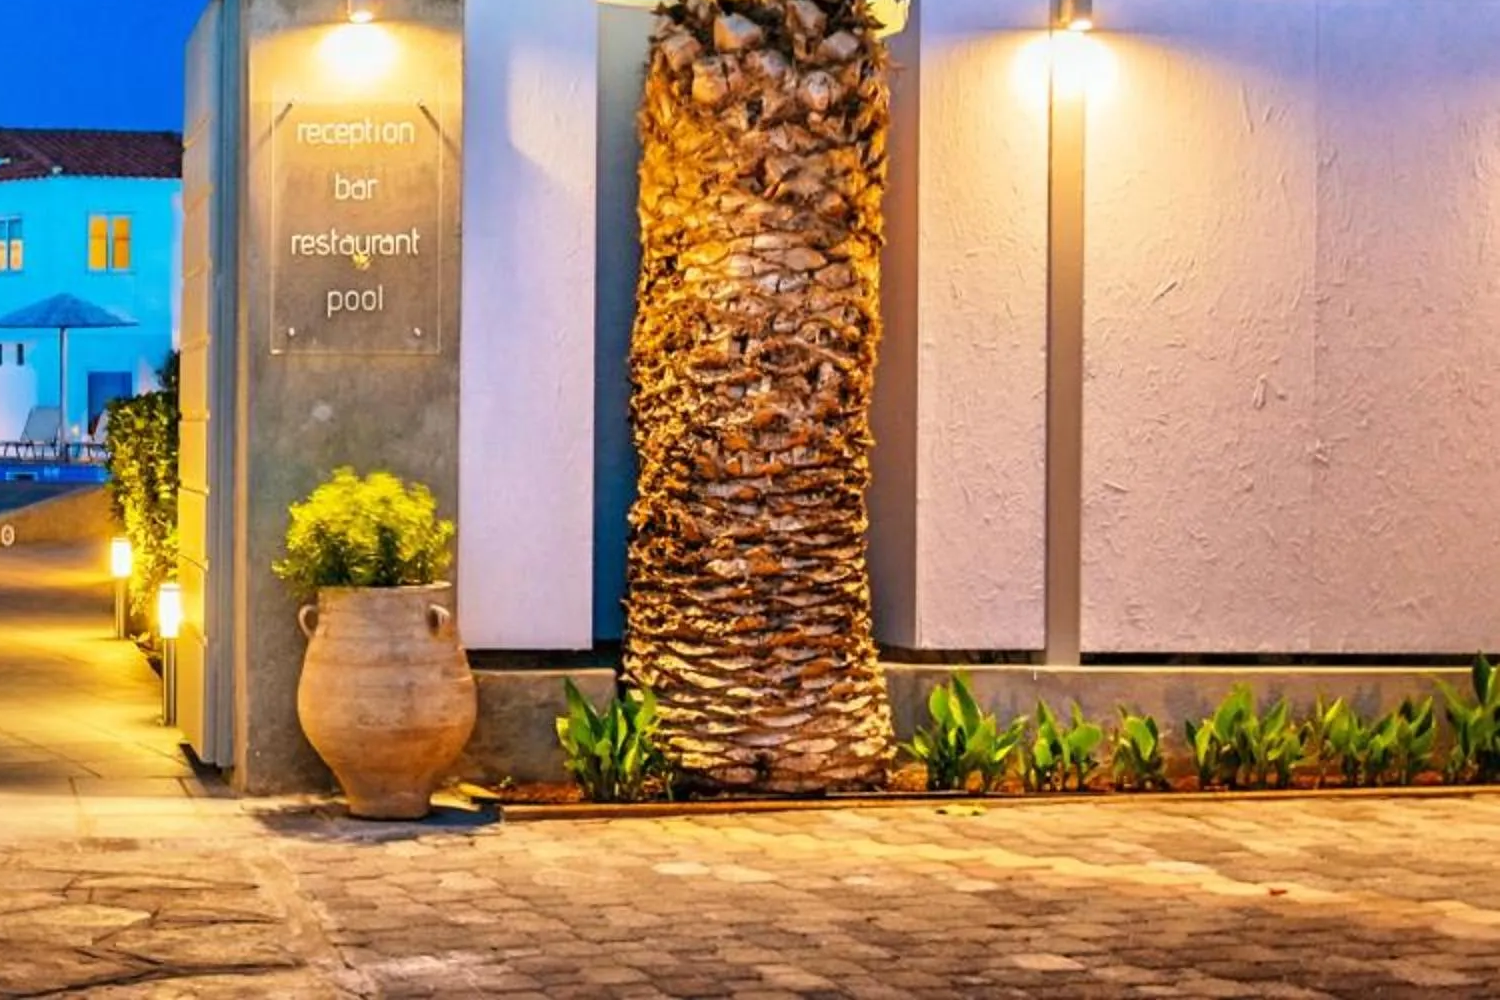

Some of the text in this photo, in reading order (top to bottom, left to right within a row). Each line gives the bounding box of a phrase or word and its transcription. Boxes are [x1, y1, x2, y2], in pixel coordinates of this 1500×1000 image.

[297, 117, 415, 149] reception
[334, 173, 379, 200] bar
[291, 227, 420, 256] restaurant
[327, 284, 384, 318] pool
